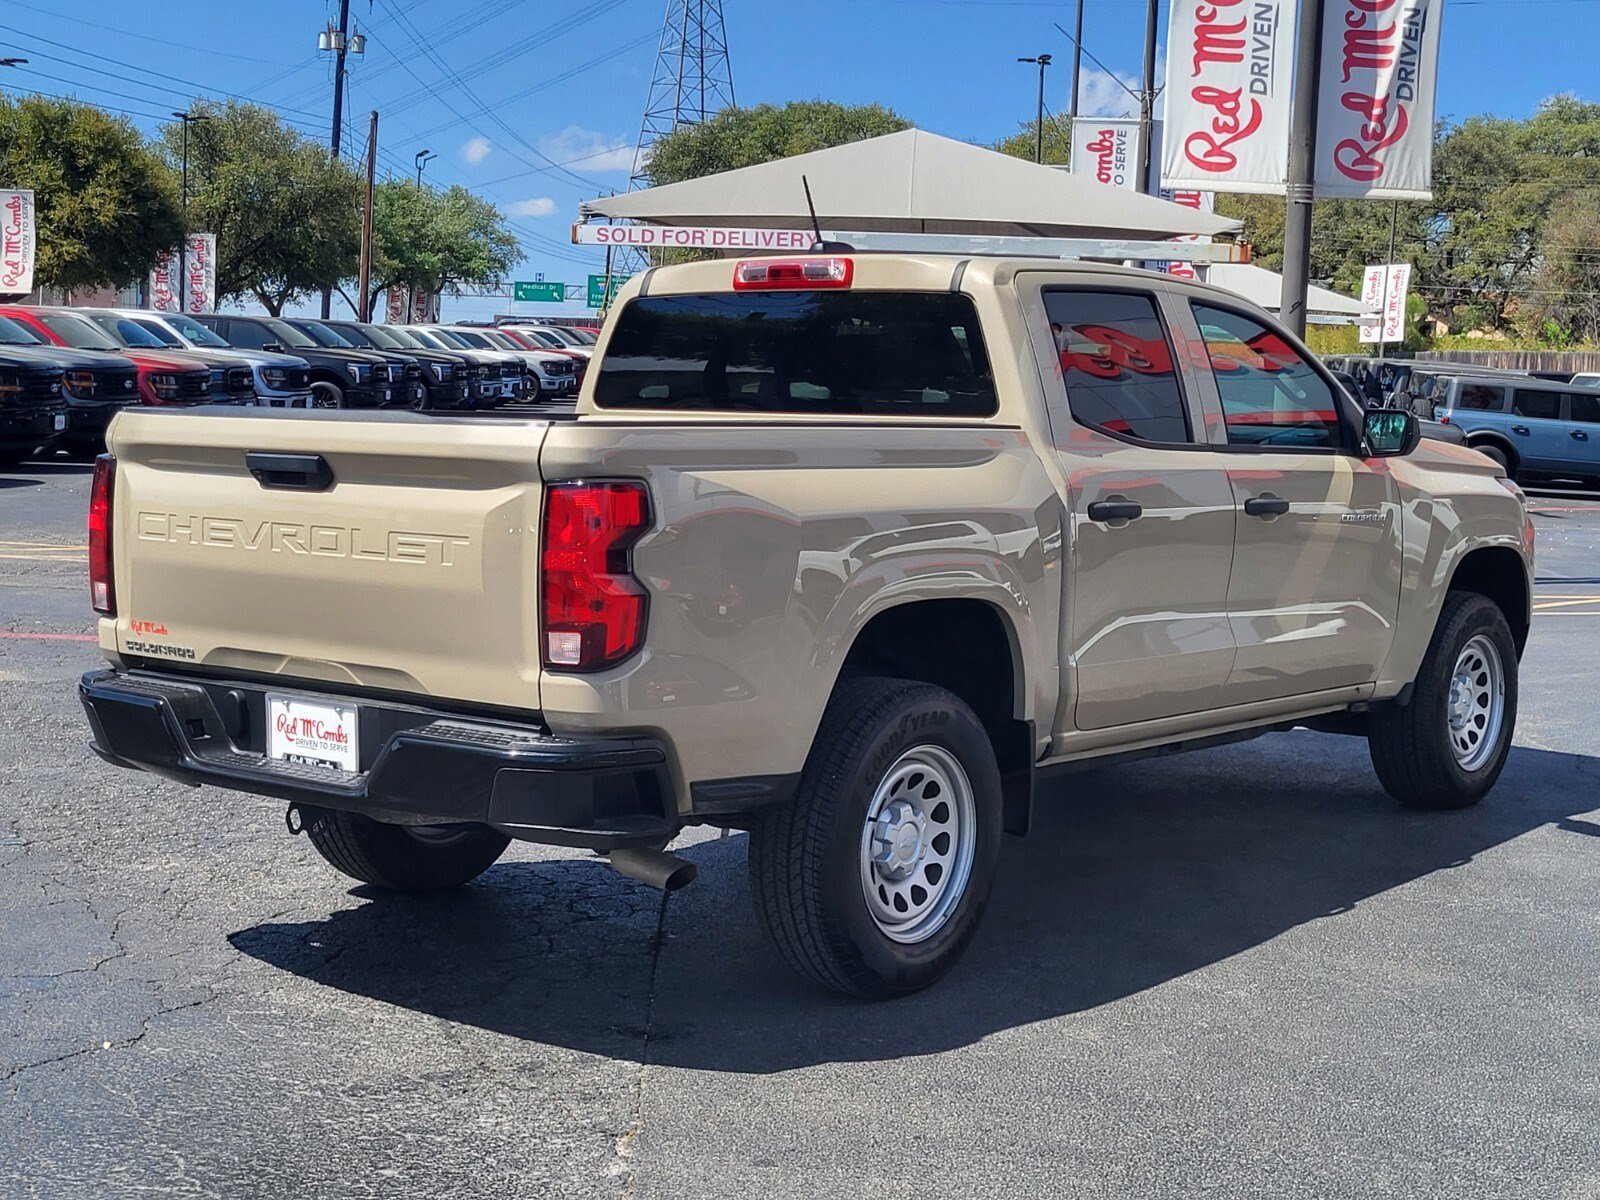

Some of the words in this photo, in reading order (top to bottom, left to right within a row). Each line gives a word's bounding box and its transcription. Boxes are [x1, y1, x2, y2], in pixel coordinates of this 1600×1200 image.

[1249, 2, 1274, 96] DRIVEN
[1395, 7, 1422, 102] DRIVEN
[1184, 85, 1263, 173] Red
[1333, 91, 1409, 182] Red
[1086, 129, 1115, 184] ombs
[1114, 129, 1127, 171] SERVE
[1113, 174, 1126, 187] O
[5, 195, 21, 258] McCombs
[22, 222, 29, 233] TO
[596, 227, 655, 244] SOLD
[662, 229, 705, 246] FOR
[712, 230, 817, 248] DELIVERY
[21, 234, 30, 264] DRIVEN
[2, 260, 26, 287] Red
[154, 289, 173, 311] Red
[189, 290, 208, 313] Red
[1388, 269, 1402, 315] McCombs
[1387, 316, 1400, 337] Red
[138, 511, 471, 567] CHEVROLET
[130, 620, 142, 636] Red
[126, 640, 196, 660] COLORADO
[277, 713, 298, 742] Red
[299, 716, 349, 745] McCombs
[295, 738, 318, 748] DRIVEN
[319, 741, 329, 750] TO
[329, 742, 349, 753] SERVE
